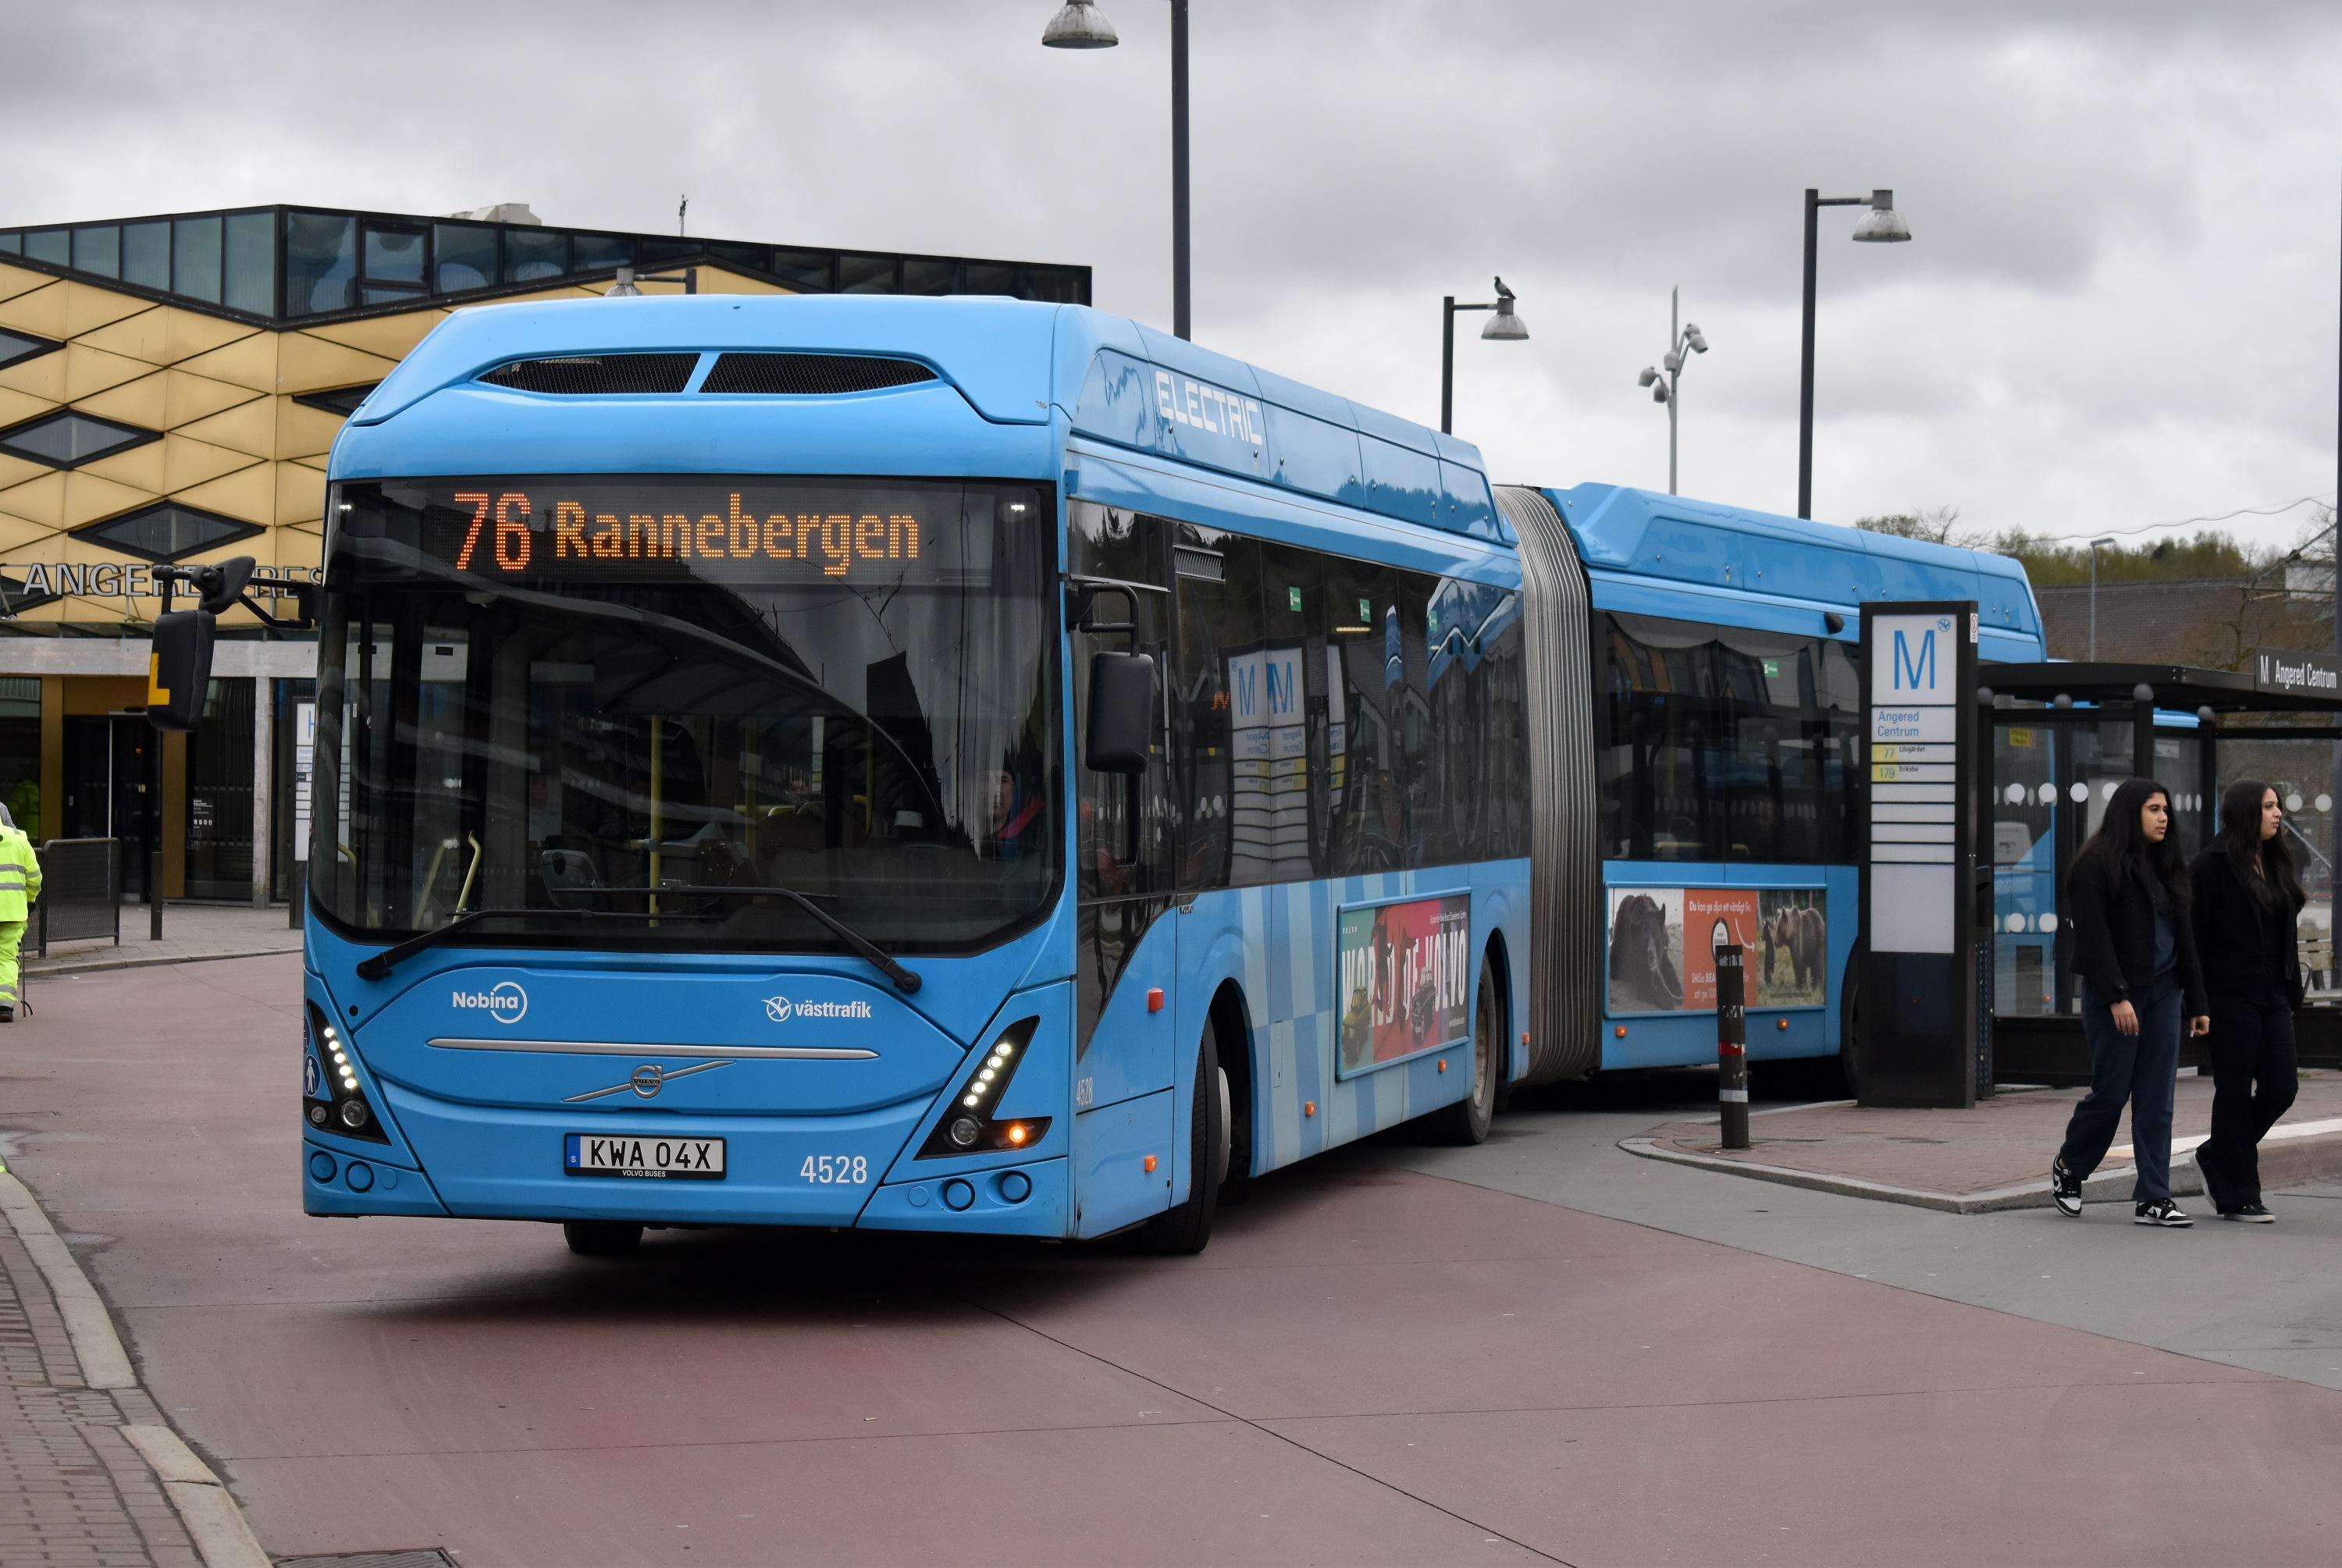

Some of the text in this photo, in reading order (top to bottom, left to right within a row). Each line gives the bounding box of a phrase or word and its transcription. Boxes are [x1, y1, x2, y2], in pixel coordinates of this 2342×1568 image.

[1155, 370, 1262, 446] ELECTRIC
[454, 493, 919, 575] 76 Rannebergen
[1894, 629, 1934, 690] M
[2261, 655, 2337, 689] M Angered Centrum
[1878, 711, 1919, 724] Angered
[1878, 725, 1919, 737] Centrum
[1884, 748, 1895, 759] 77
[1879, 767, 1895, 779] 179
[1689, 901, 1697, 912] Du
[1697, 900, 1706, 912] kan
[1706, 904, 1713, 915] ge
[1714, 900, 1722, 915] djur
[1425, 929, 1466, 1012] VOLVO
[453, 991, 518, 1009] Nobina
[795, 1000, 872, 1019] västtrafik
[1077, 1076, 1093, 1106] 4528
[591, 1140, 711, 1169] KWA 04X
[800, 1155, 867, 1185] 4528
